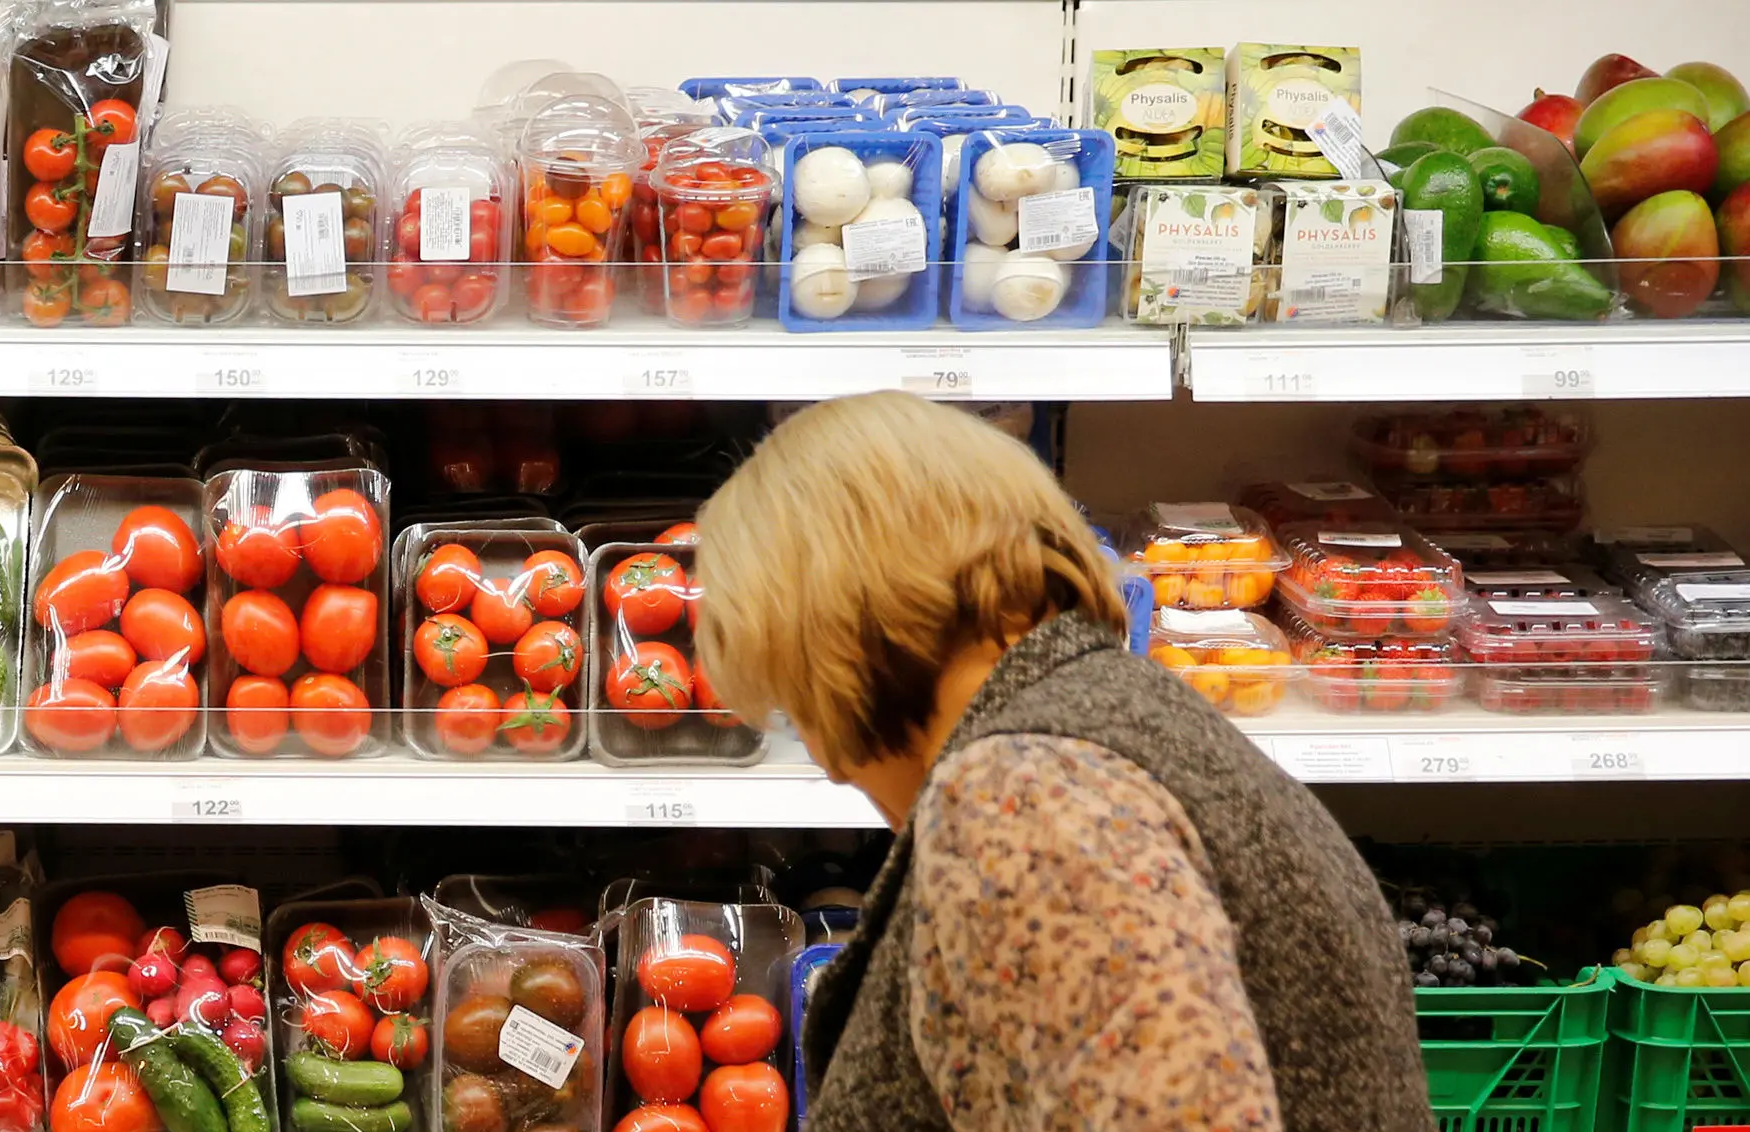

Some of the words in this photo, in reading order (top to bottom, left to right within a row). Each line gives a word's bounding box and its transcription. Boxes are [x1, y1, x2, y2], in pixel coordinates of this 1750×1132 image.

[1131, 93, 1188, 107] Physalis
[1276, 88, 1329, 103] Physalis
[1228, 82, 1238, 142] Physalis
[1158, 223, 1240, 237] PHYSALIS
[1296, 229, 1377, 242] PHYSALIS
[47, 369, 84, 386] 129
[214, 369, 250, 386] 150
[413, 369, 449, 387] 129
[641, 370, 677, 387] 157
[933, 371, 958, 388] 79
[1264, 374, 1301, 391] 111
[1554, 370, 1580, 388] 99
[1421, 757, 1458, 773] 279
[1590, 753, 1627, 769] 268
[192, 800, 229, 815] 122
[646, 803, 683, 819] 115
